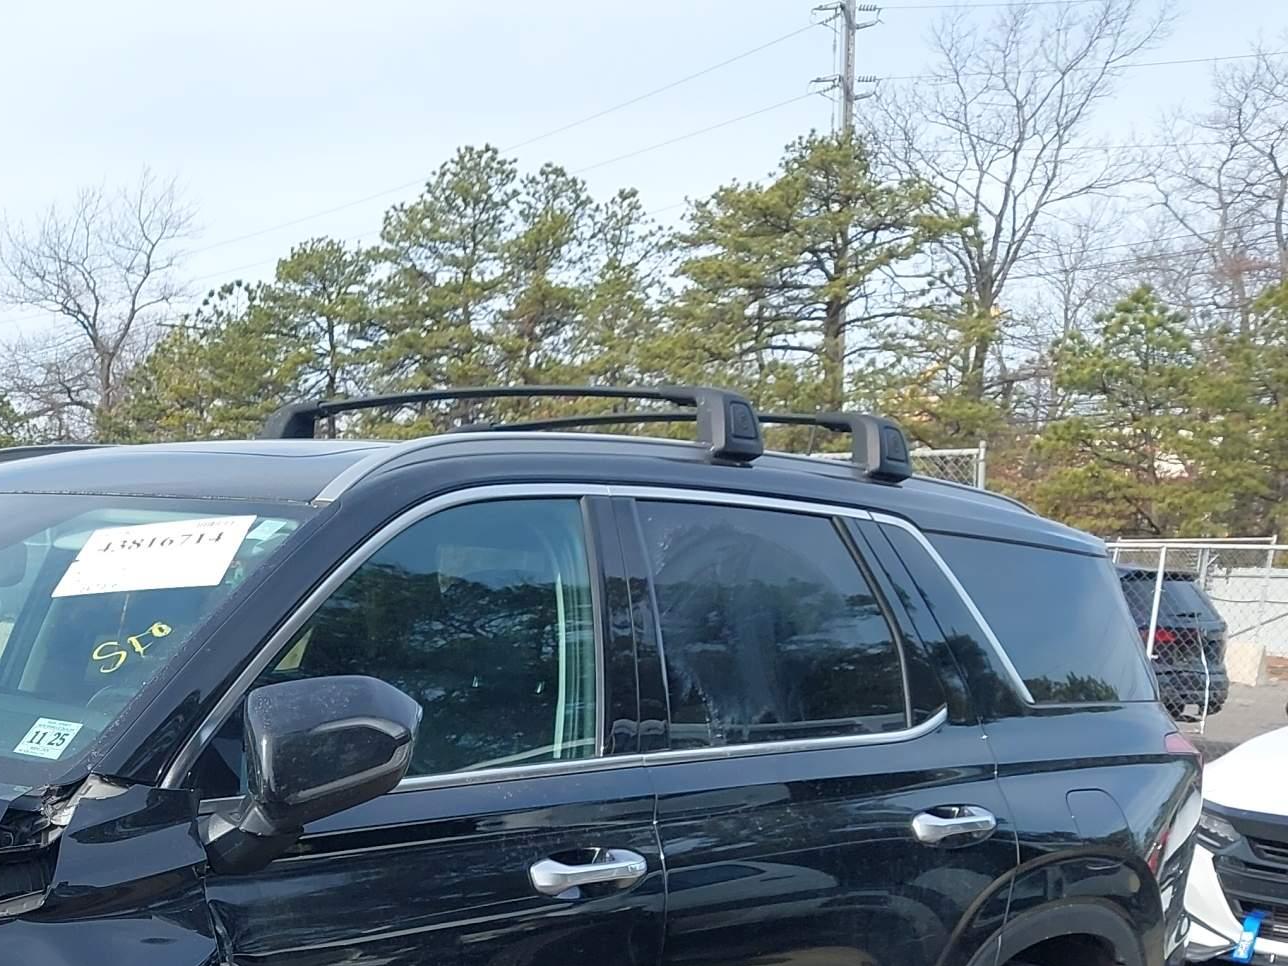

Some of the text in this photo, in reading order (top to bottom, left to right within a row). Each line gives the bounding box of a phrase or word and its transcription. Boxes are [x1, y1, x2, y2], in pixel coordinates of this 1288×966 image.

[97, 531, 224, 553] 43816714
[27, 730, 70, 747] 11 25
